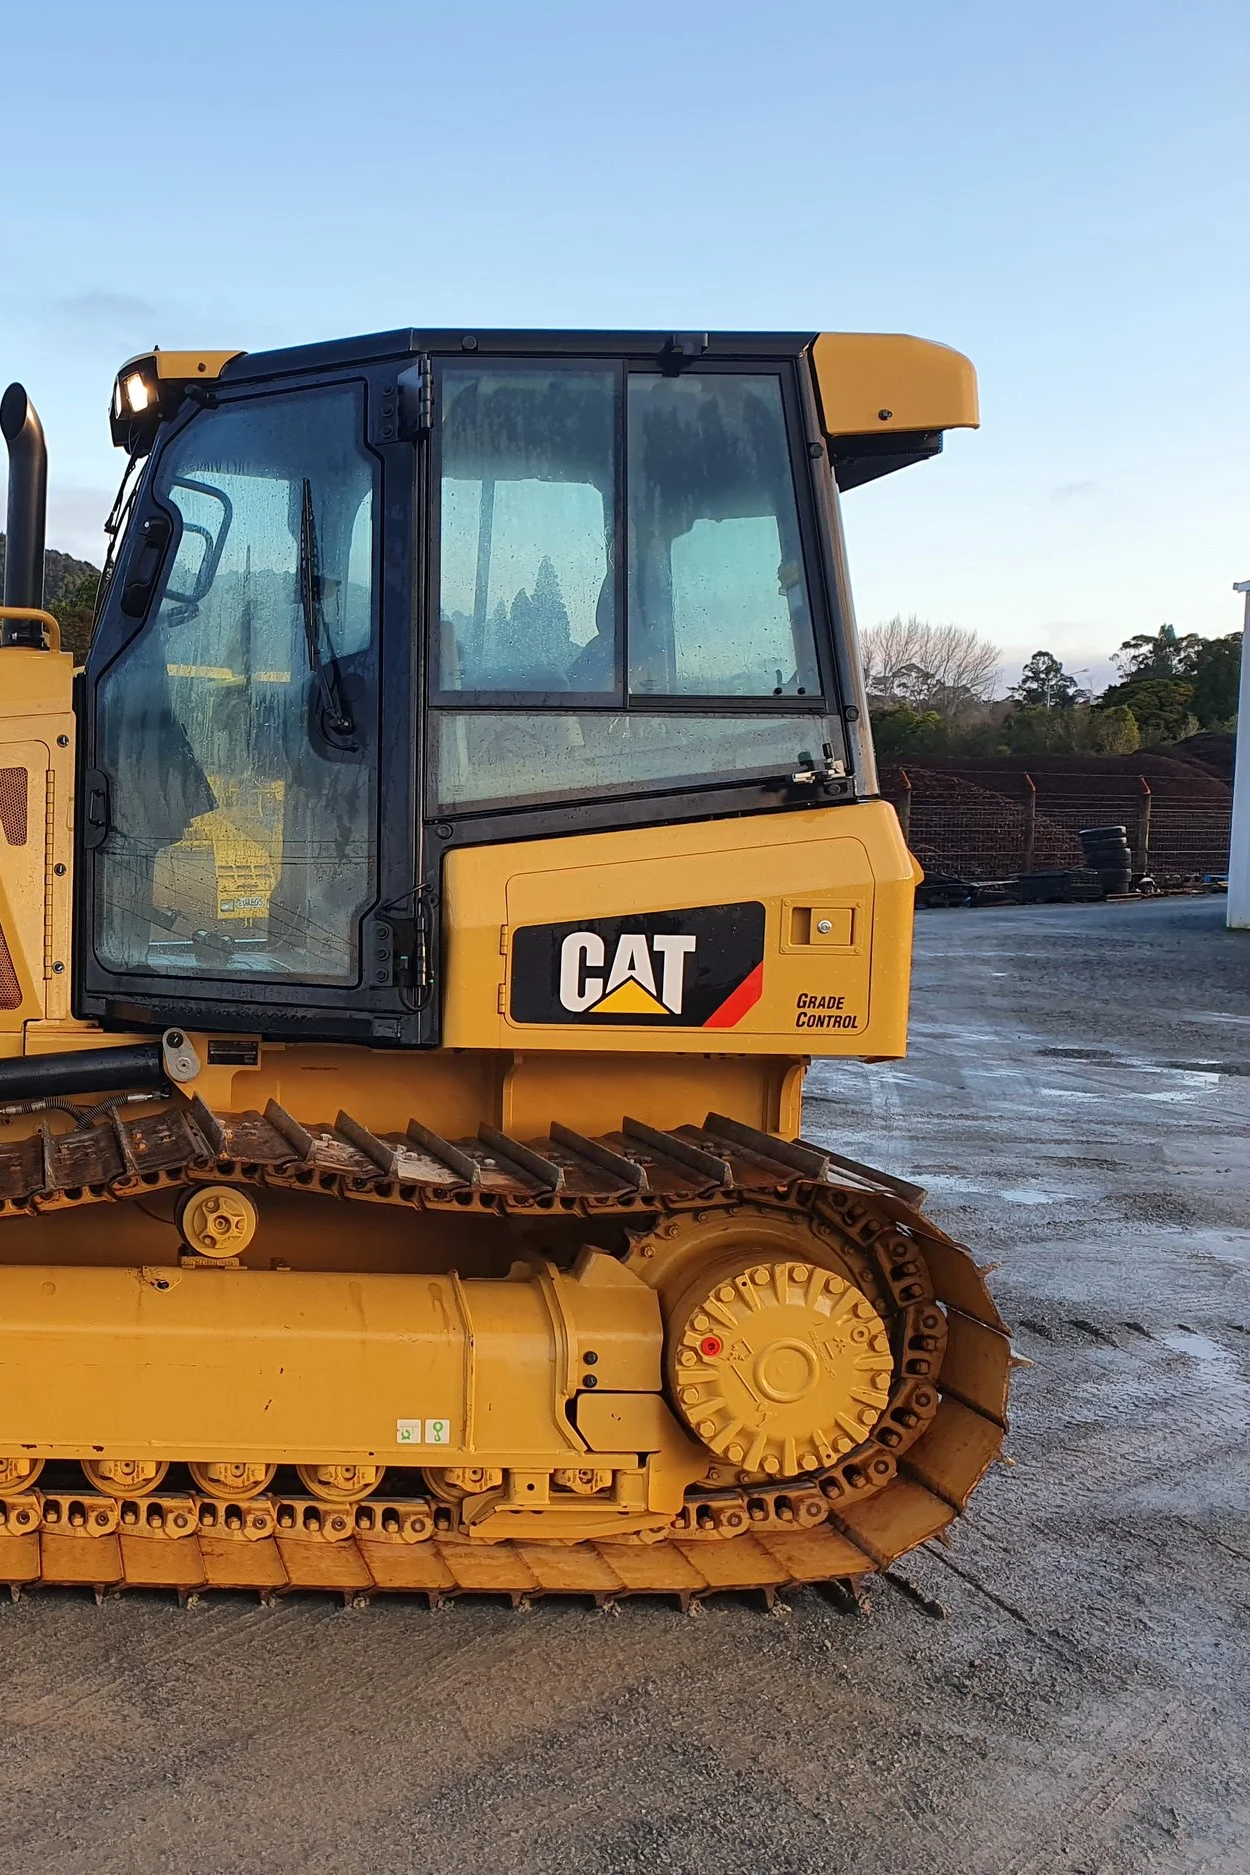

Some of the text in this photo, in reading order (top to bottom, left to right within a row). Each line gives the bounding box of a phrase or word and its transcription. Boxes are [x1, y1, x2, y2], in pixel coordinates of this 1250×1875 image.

[559, 931, 697, 1015] CAT
[796, 992, 846, 1010] GRADE
[795, 1011, 859, 1029] CONTROL
